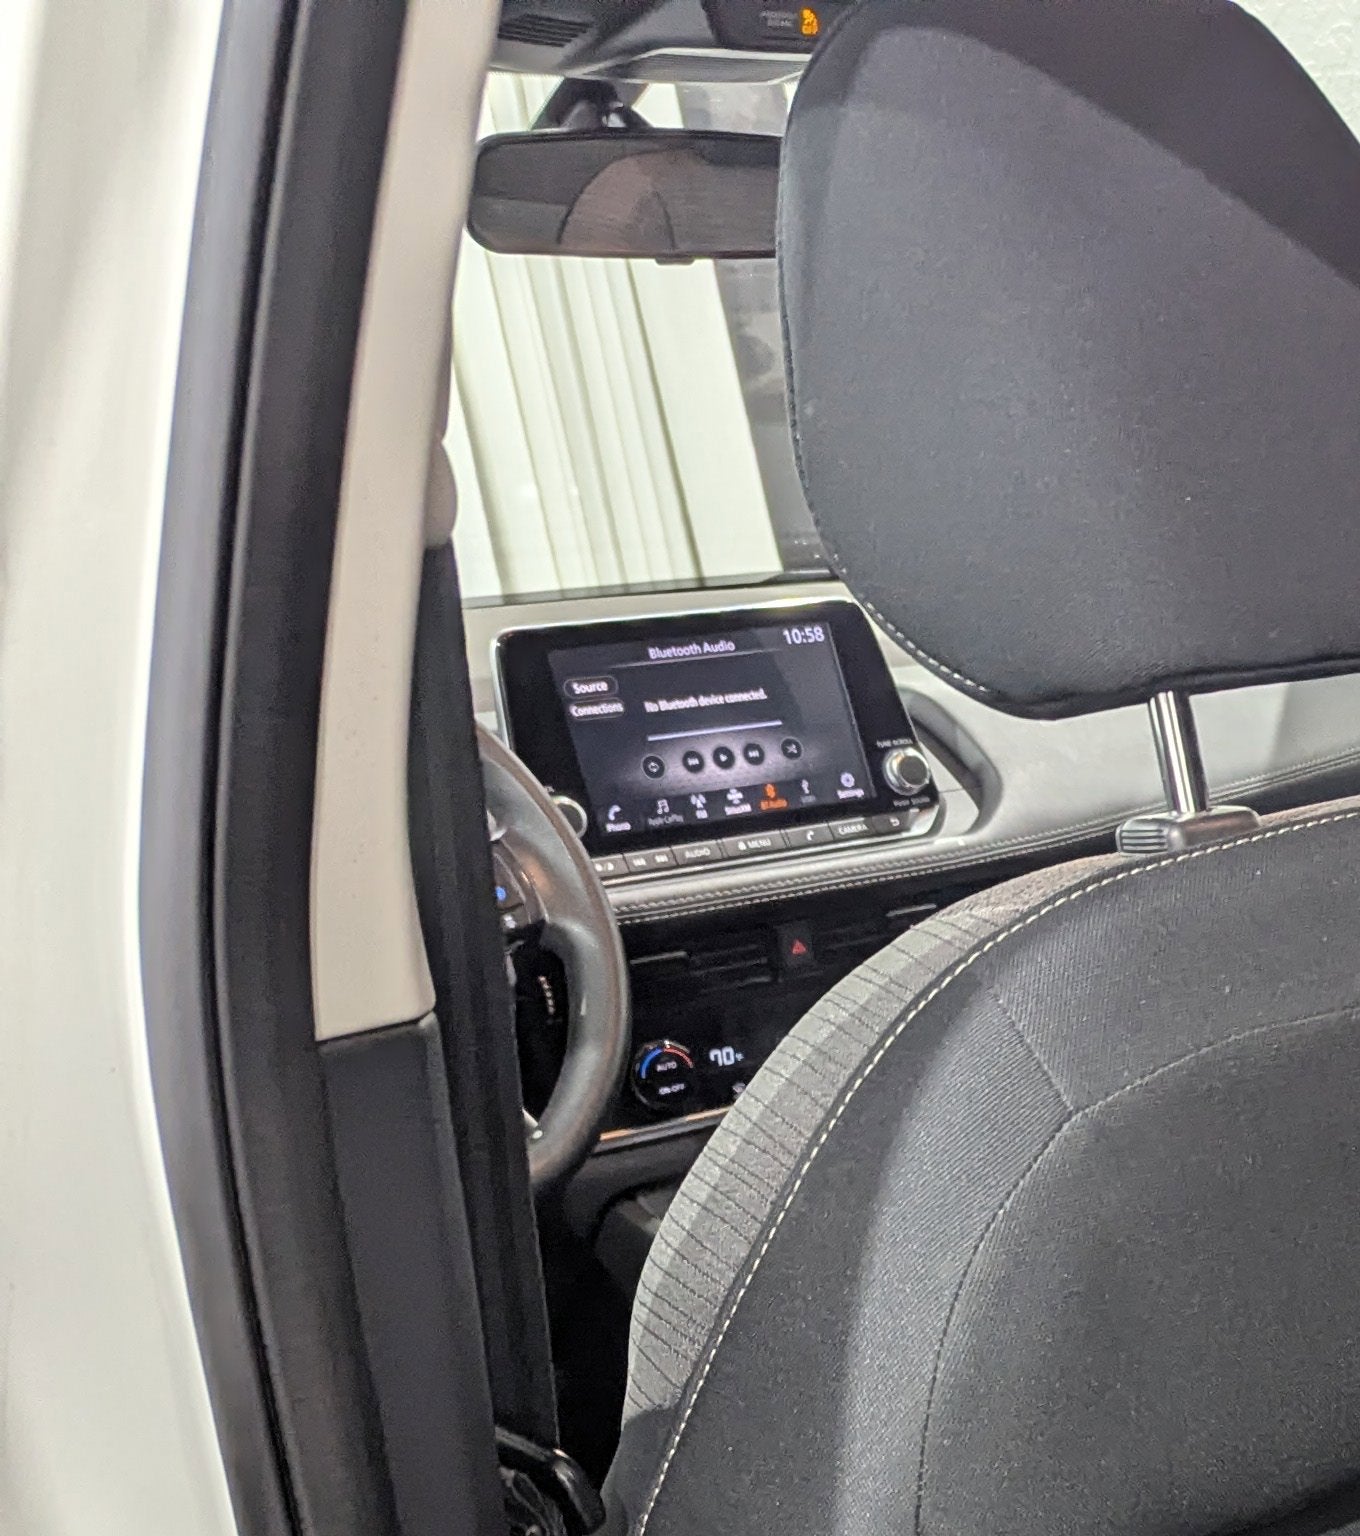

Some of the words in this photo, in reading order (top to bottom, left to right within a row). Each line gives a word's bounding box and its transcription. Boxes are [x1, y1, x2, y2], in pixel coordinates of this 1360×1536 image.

[783, 626, 825, 645] 10:58
[648, 643, 701, 659] Bluetooth
[703, 640, 735, 653] Audio
[572, 681, 609, 695] Source
[569, 702, 624, 718] Connections
[643, 700, 659, 713] No
[658, 696, 699, 711] Bluetooth
[699, 693, 725, 707] device
[838, 824, 868, 835] CAMERA
[747, 838, 772, 849] MENU
[684, 847, 711, 859] AUDIO
[657, 1061, 677, 1072] AUTO
